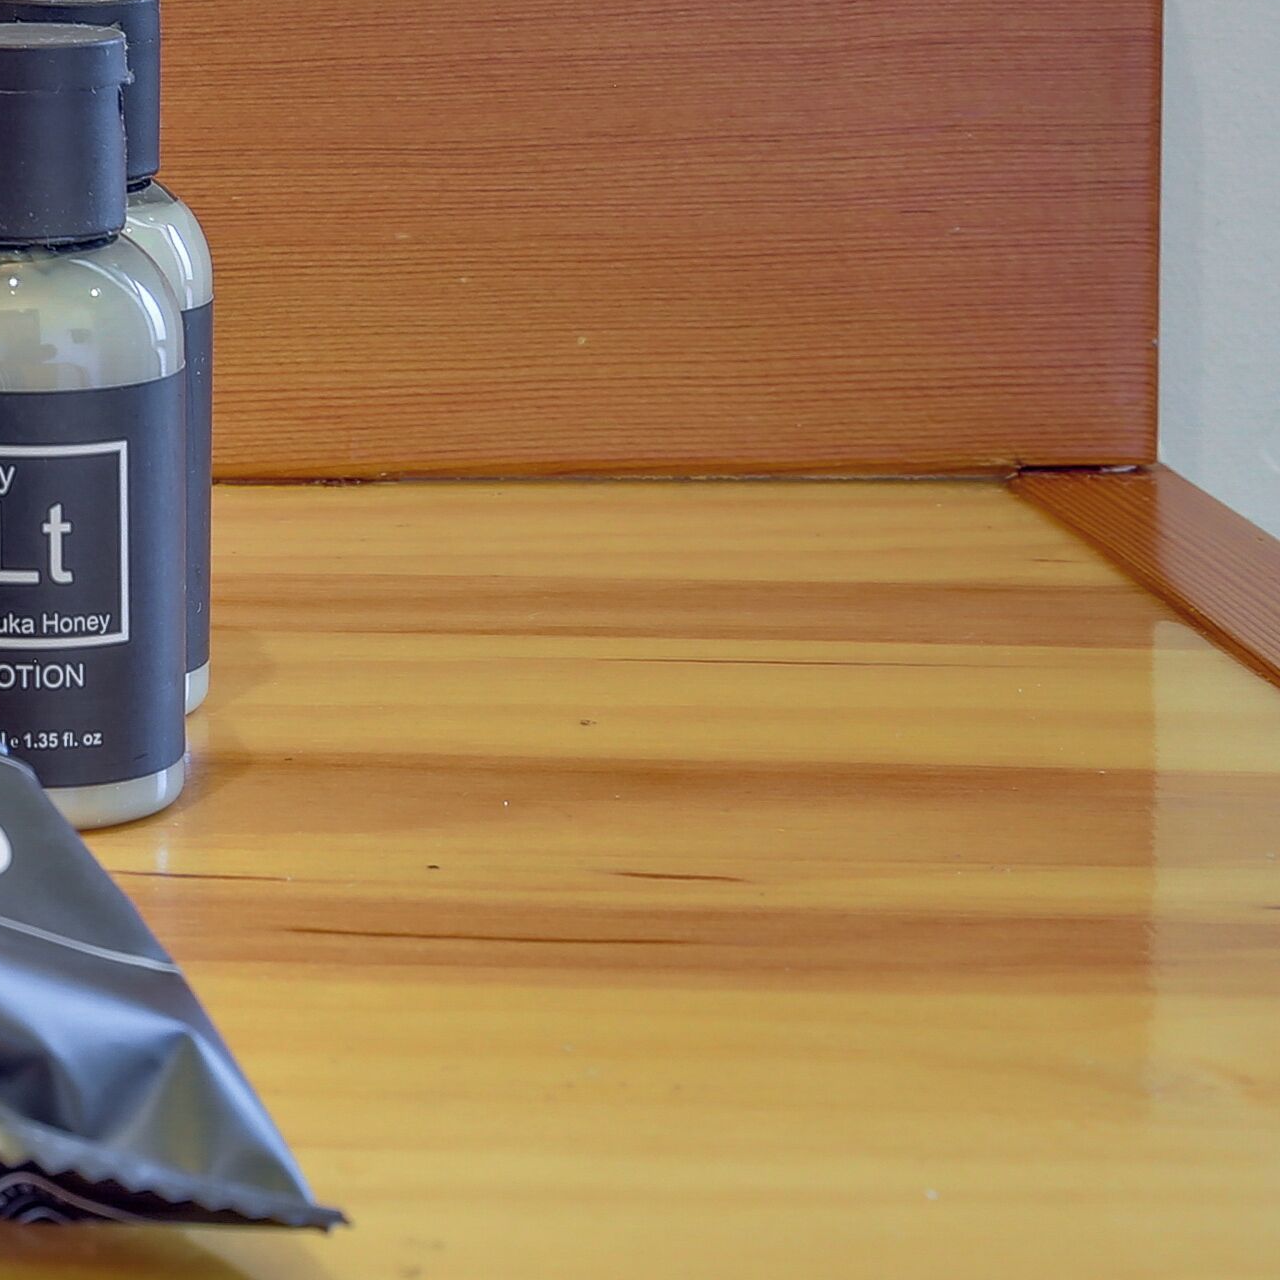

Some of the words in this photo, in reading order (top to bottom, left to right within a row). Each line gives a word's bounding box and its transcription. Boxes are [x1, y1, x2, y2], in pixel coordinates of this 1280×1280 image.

[42, 612, 110, 635] Honey
[24, 732, 58, 748] 1.35
[63, 732, 78, 747] fl.
[83, 733, 102, 746] oz
